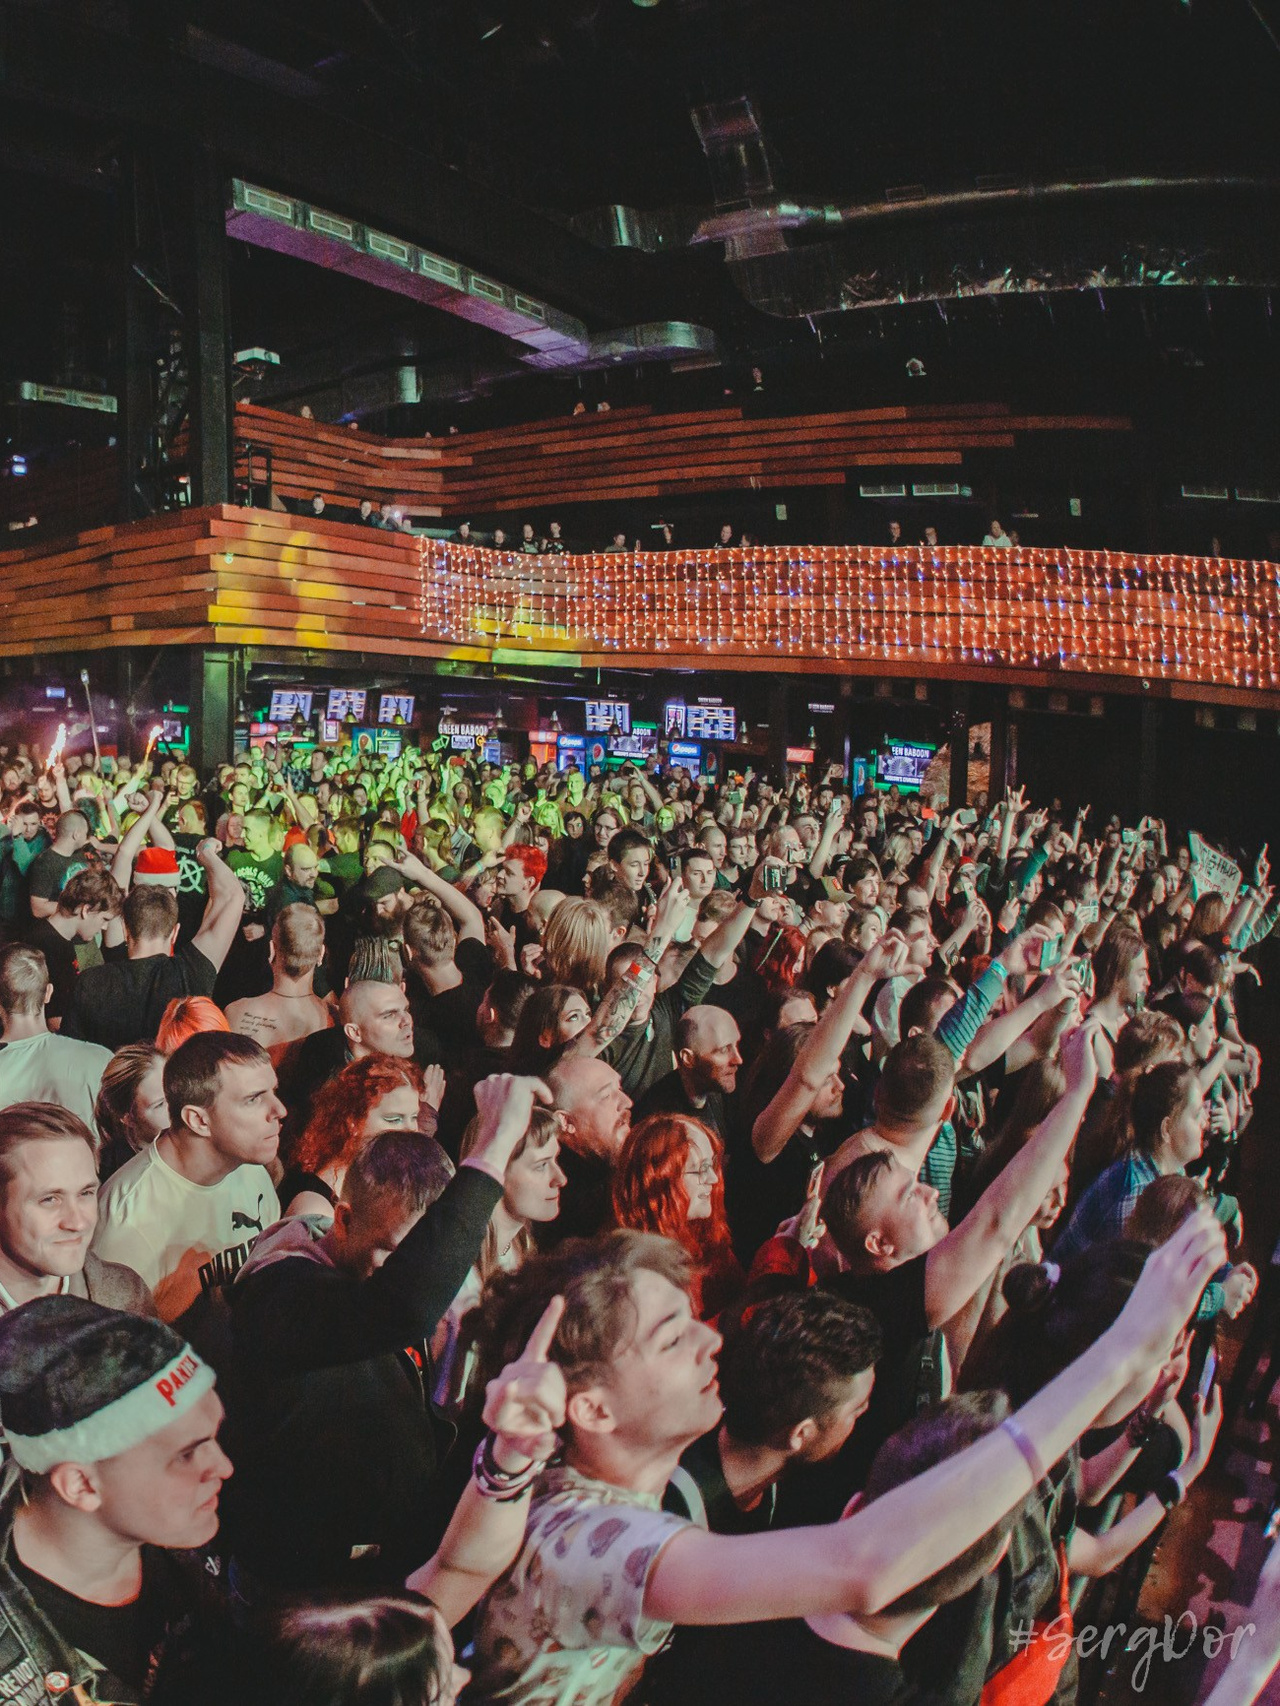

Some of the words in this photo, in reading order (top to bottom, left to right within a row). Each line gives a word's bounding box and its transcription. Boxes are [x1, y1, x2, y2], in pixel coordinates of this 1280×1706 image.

[438, 723, 459, 735] GREEN
[632, 727, 652, 736] ABOON
[904, 747, 930, 758] BABOON
